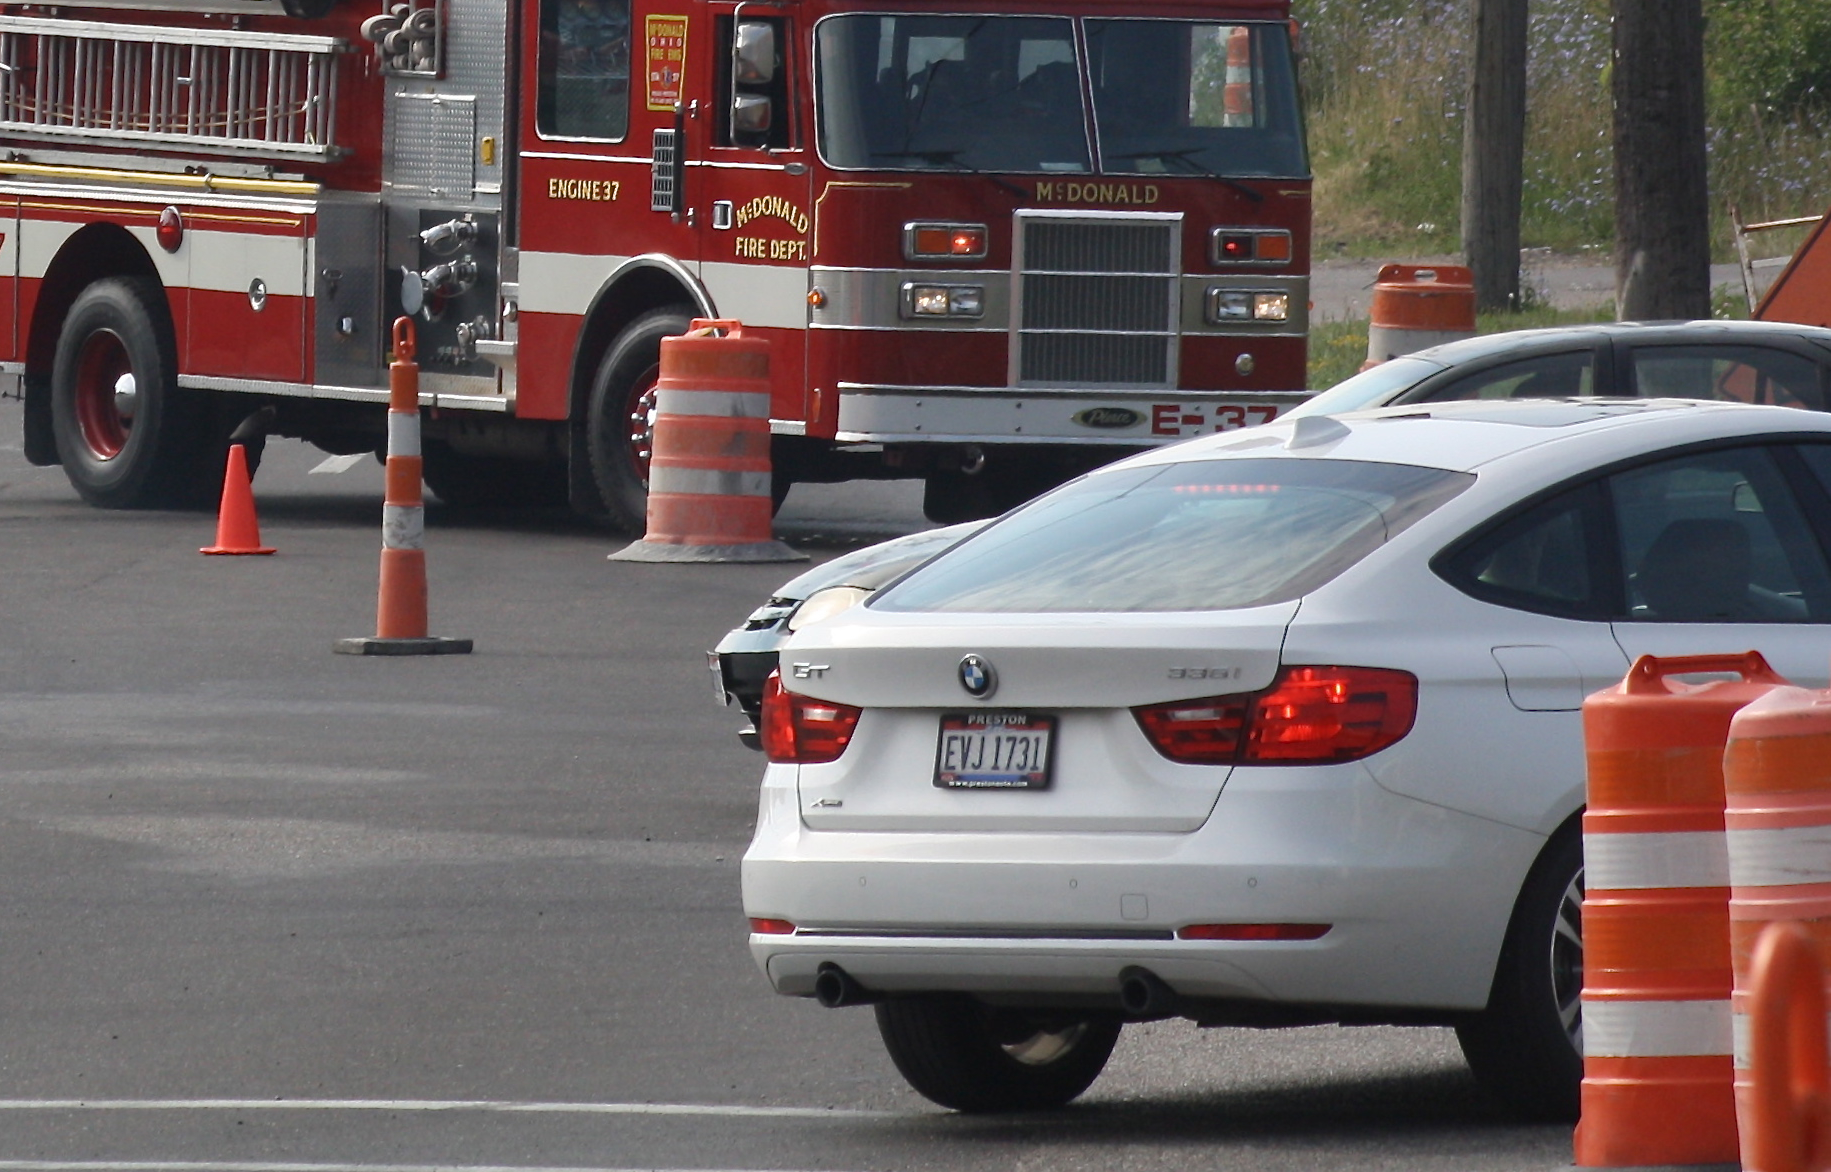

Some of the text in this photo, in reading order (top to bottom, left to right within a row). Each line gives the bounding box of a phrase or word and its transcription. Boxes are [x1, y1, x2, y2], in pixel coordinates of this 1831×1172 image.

[549, 178, 620, 201] ENGINE 37
[736, 237, 807, 261] FIRE DEPT.
[793, 662, 830, 678] GT
[968, 715, 1027, 725] PRESTON
[944, 735, 1040, 771] EVJ 1731
